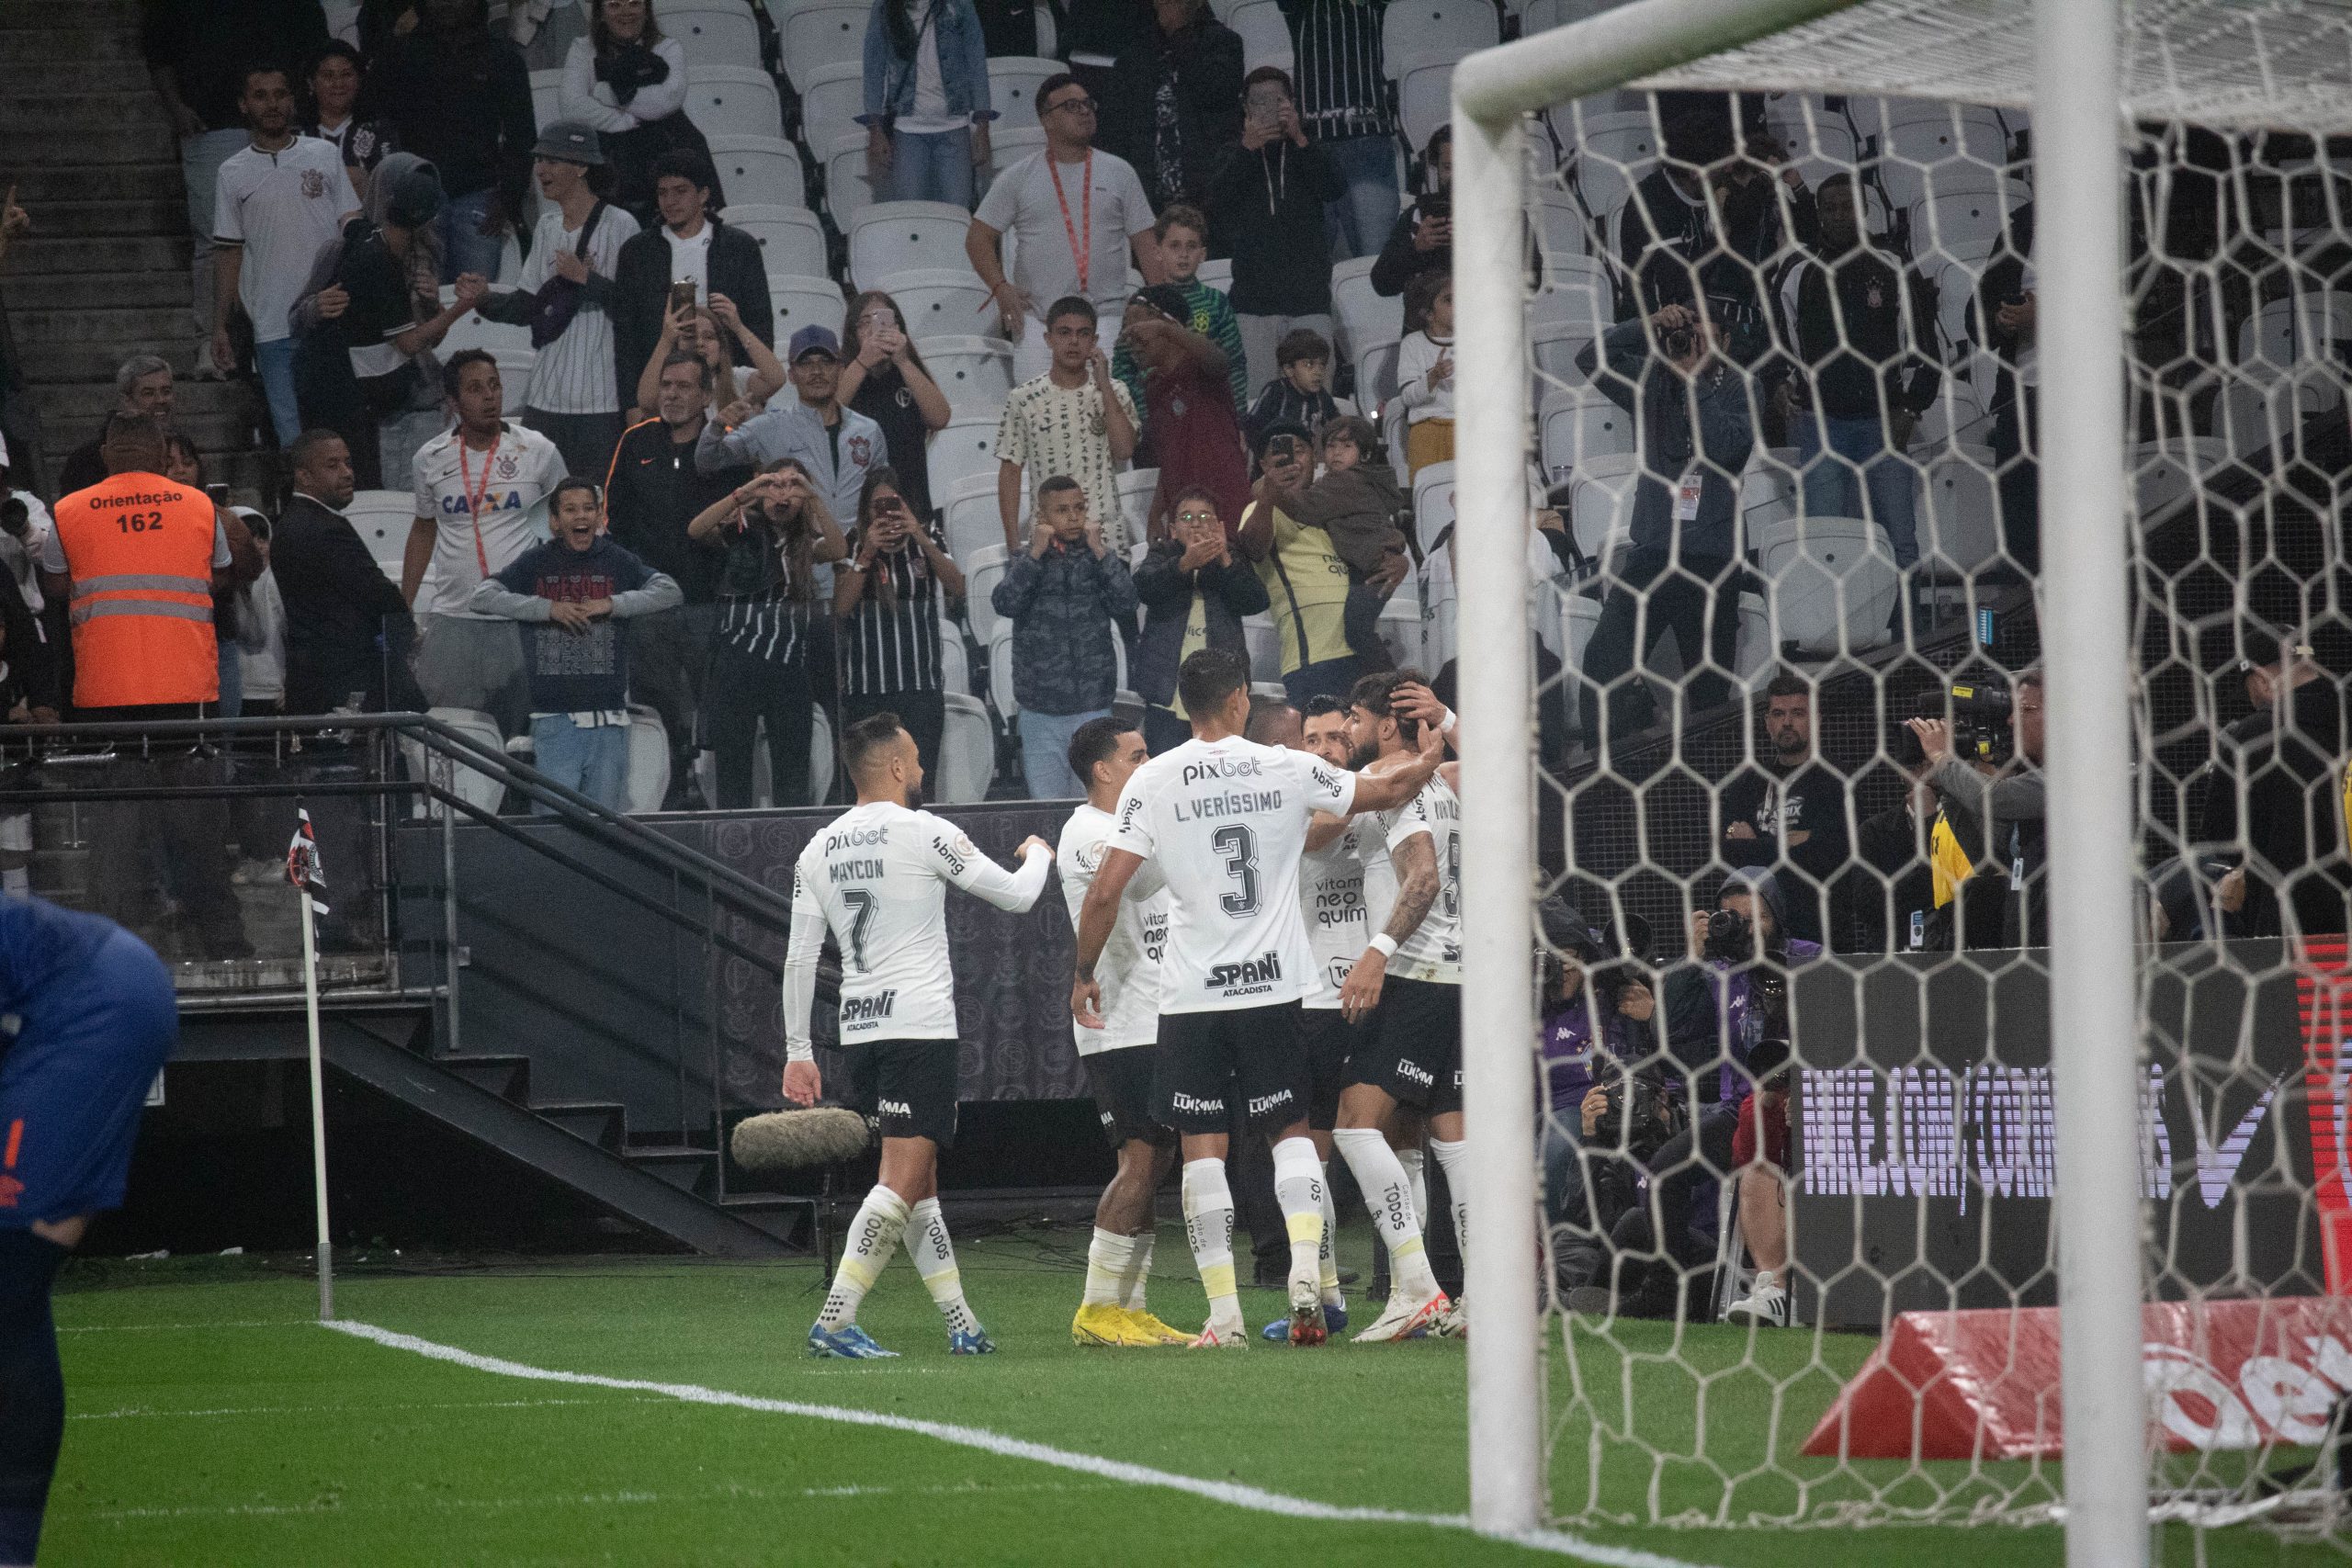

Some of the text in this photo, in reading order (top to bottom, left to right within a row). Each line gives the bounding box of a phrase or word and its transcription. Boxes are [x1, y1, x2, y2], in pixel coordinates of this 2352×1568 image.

[90, 491, 183, 509] Orientação
[117, 512, 163, 533] 162
[1183, 756, 1262, 785] pixbet
[1317, 768, 1342, 798] bmg
[1121, 797, 1142, 829] bmg
[825, 826, 888, 857] pixbet
[830, 859, 884, 883] MAYCON
[937, 839, 966, 875] bmg
[1211, 822, 1262, 919] 3
[1317, 892, 1357, 908] neo
[842, 888, 879, 974] 7
[1318, 906, 1368, 929] quím
[1223, 985, 1273, 998] ATACADISTA
[847, 1021, 879, 1032] ATACADISTA
[1384, 1182, 1406, 1230] TODOS
[857, 1211, 886, 1256] TODOS
[925, 1217, 949, 1260] TODOS
